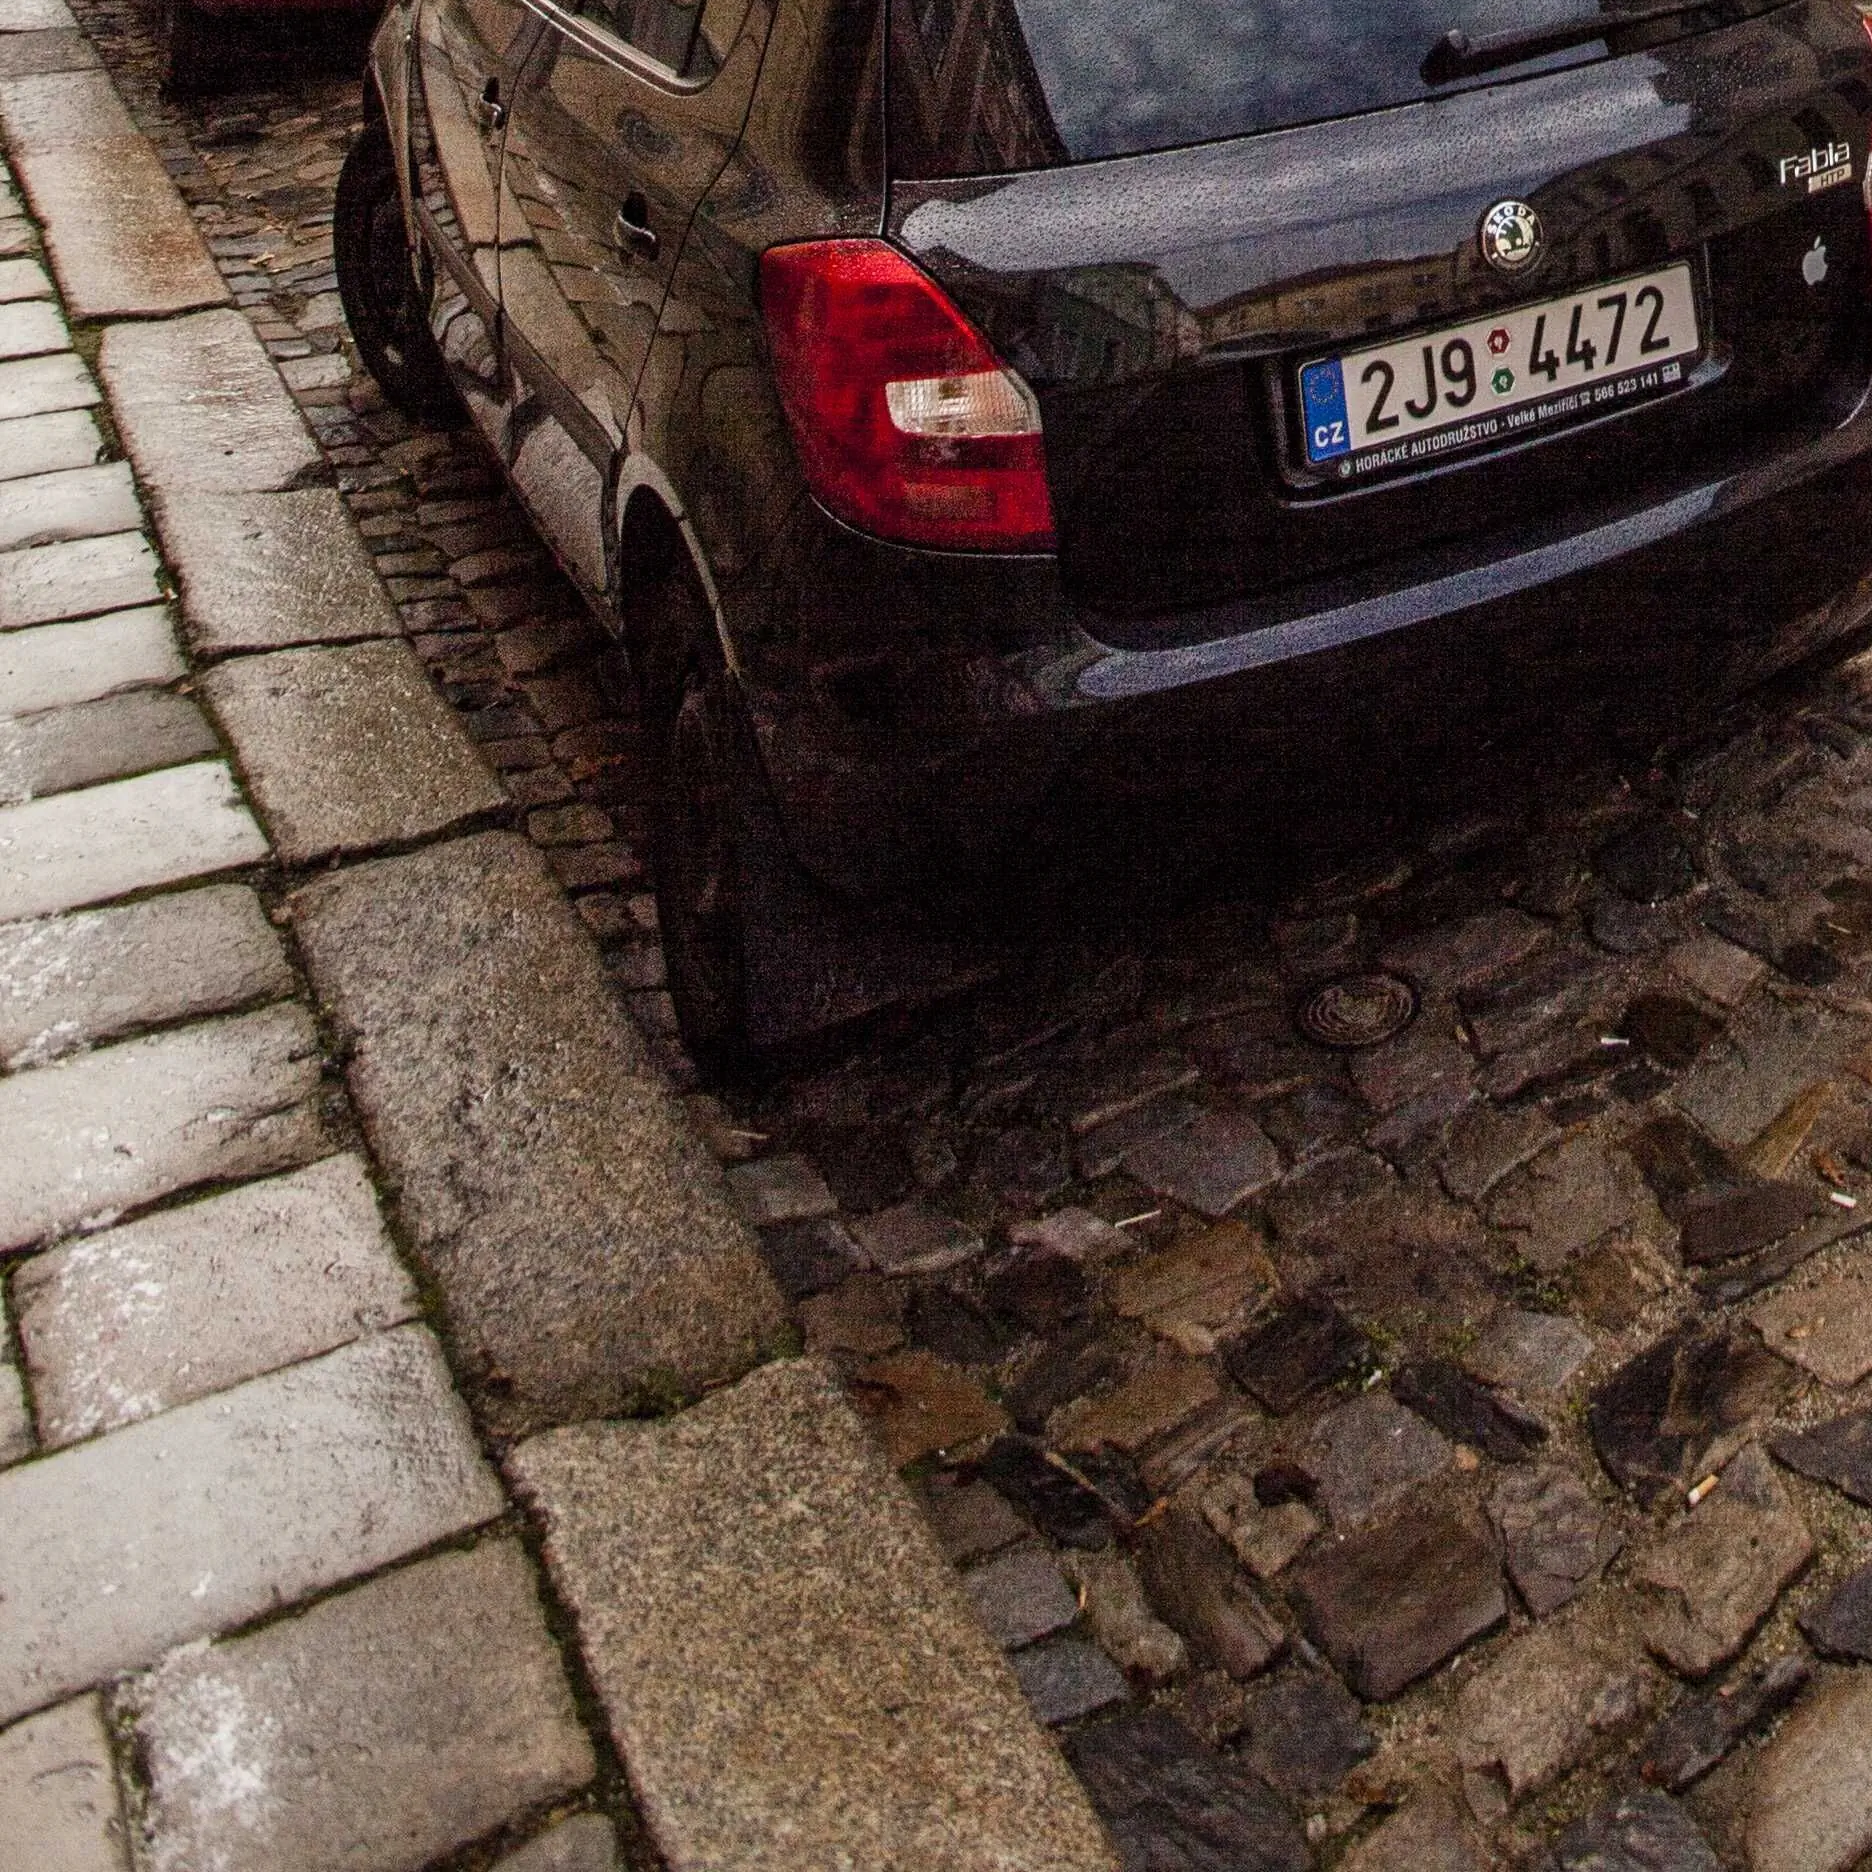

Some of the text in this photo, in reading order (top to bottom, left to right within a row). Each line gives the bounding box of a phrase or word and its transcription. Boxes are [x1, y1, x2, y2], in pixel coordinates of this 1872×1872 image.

[1821, 167, 1845, 187] HTP
[1360, 285, 1671, 435] 2J9 4472
[1314, 421, 1344, 448] CZ
[1411, 419, 1498, 457] AUTODRUŽSTVO
